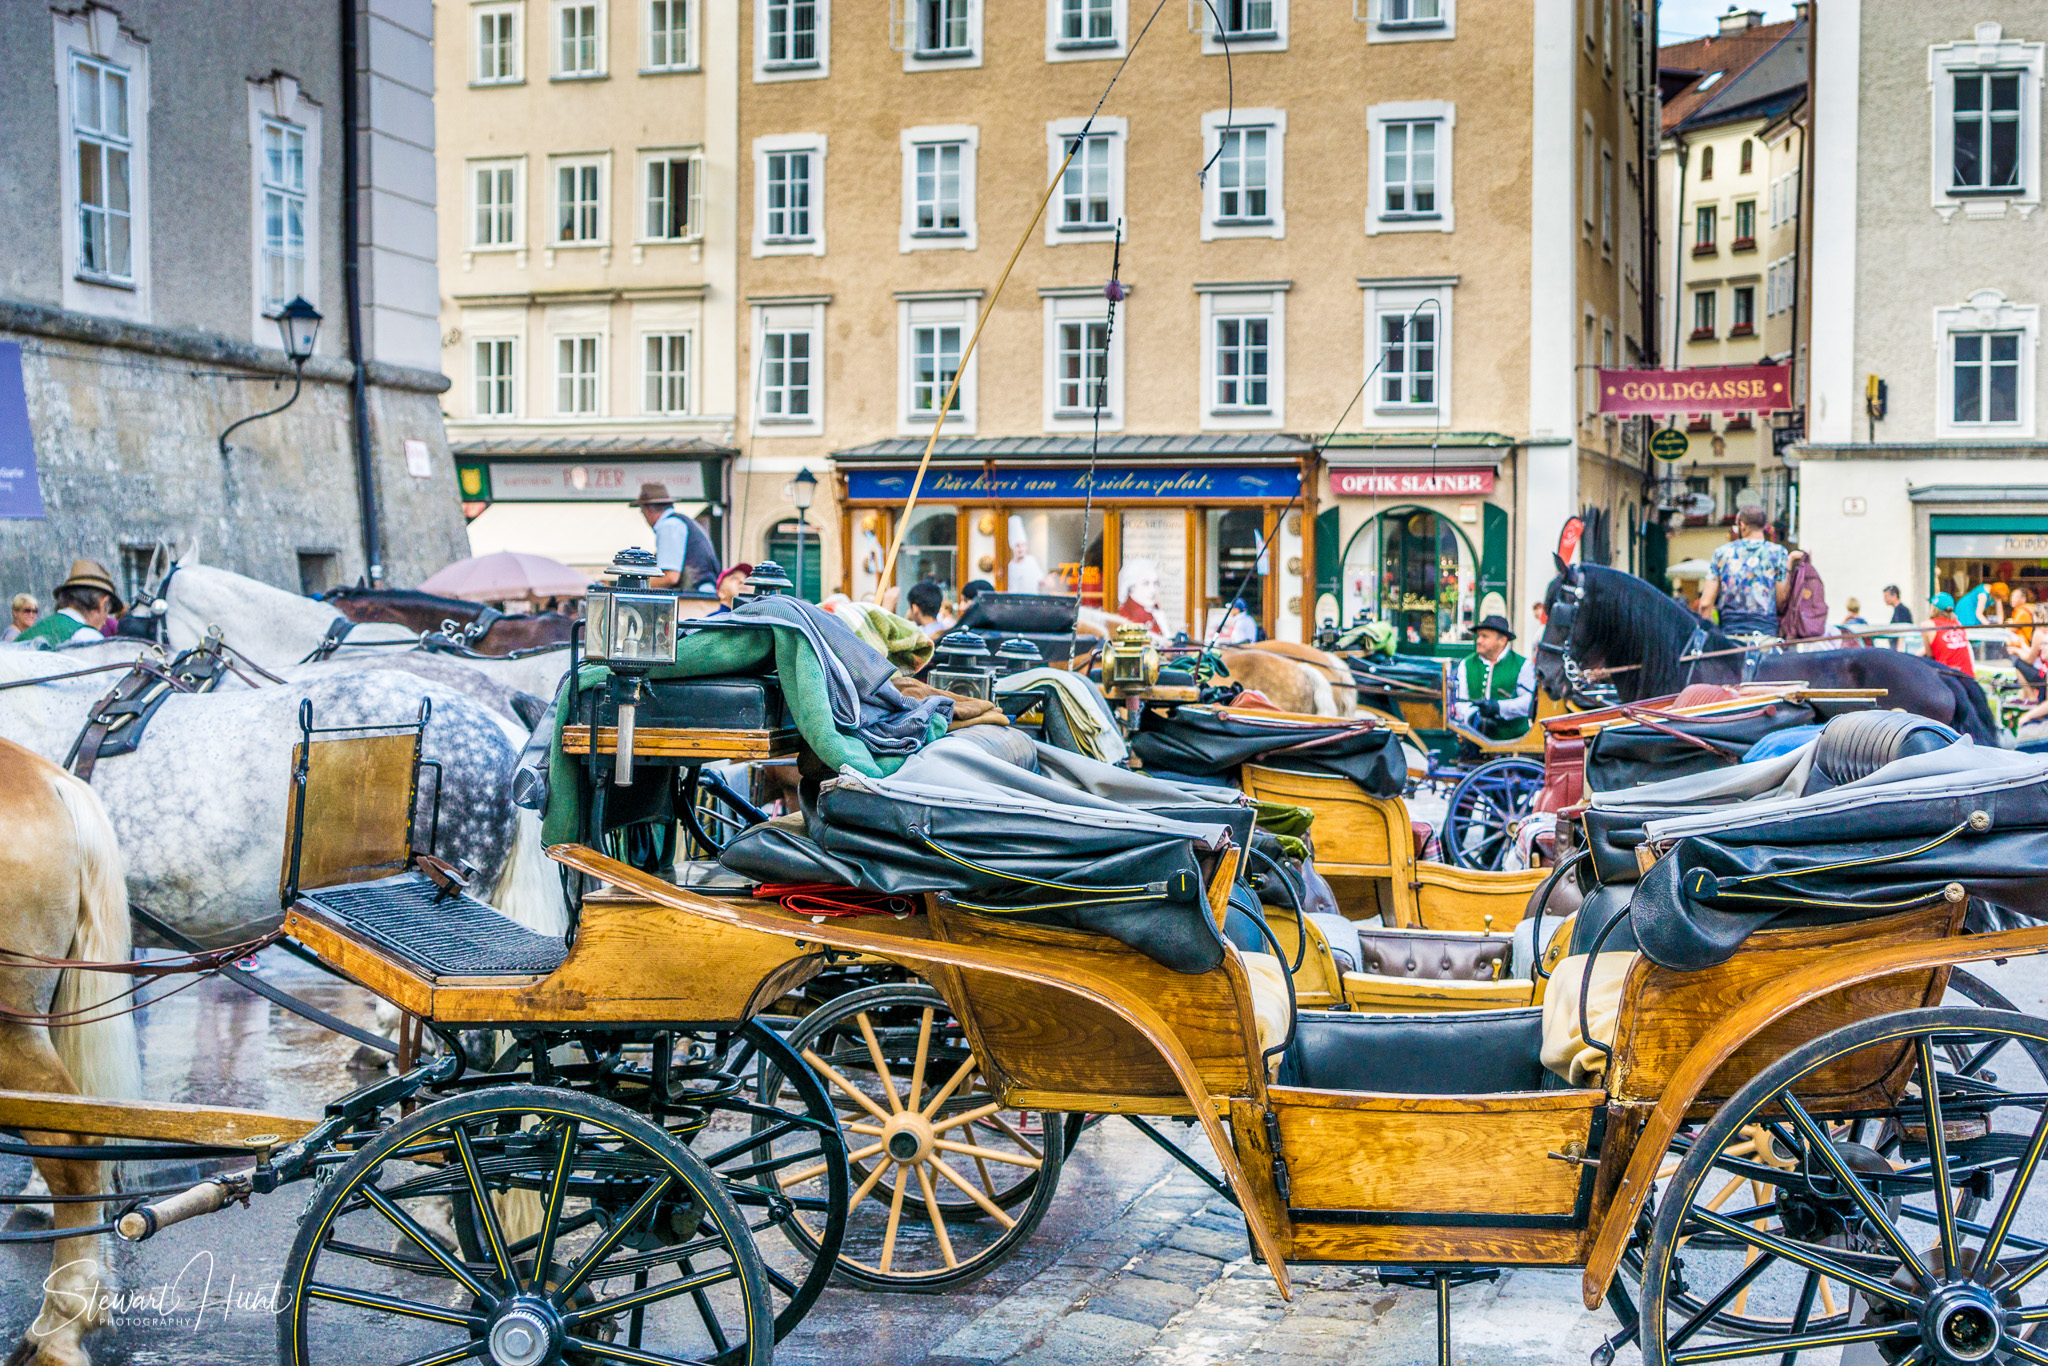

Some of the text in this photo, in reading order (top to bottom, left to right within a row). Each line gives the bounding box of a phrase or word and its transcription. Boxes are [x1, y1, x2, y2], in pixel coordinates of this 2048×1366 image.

[1623, 379, 1767, 401] GOLDGASSE
[927, 472, 1022, 491] Bäckerei
[1024, 480, 1057, 490] am
[1341, 474, 1482, 492] OPTIK SLATNER
